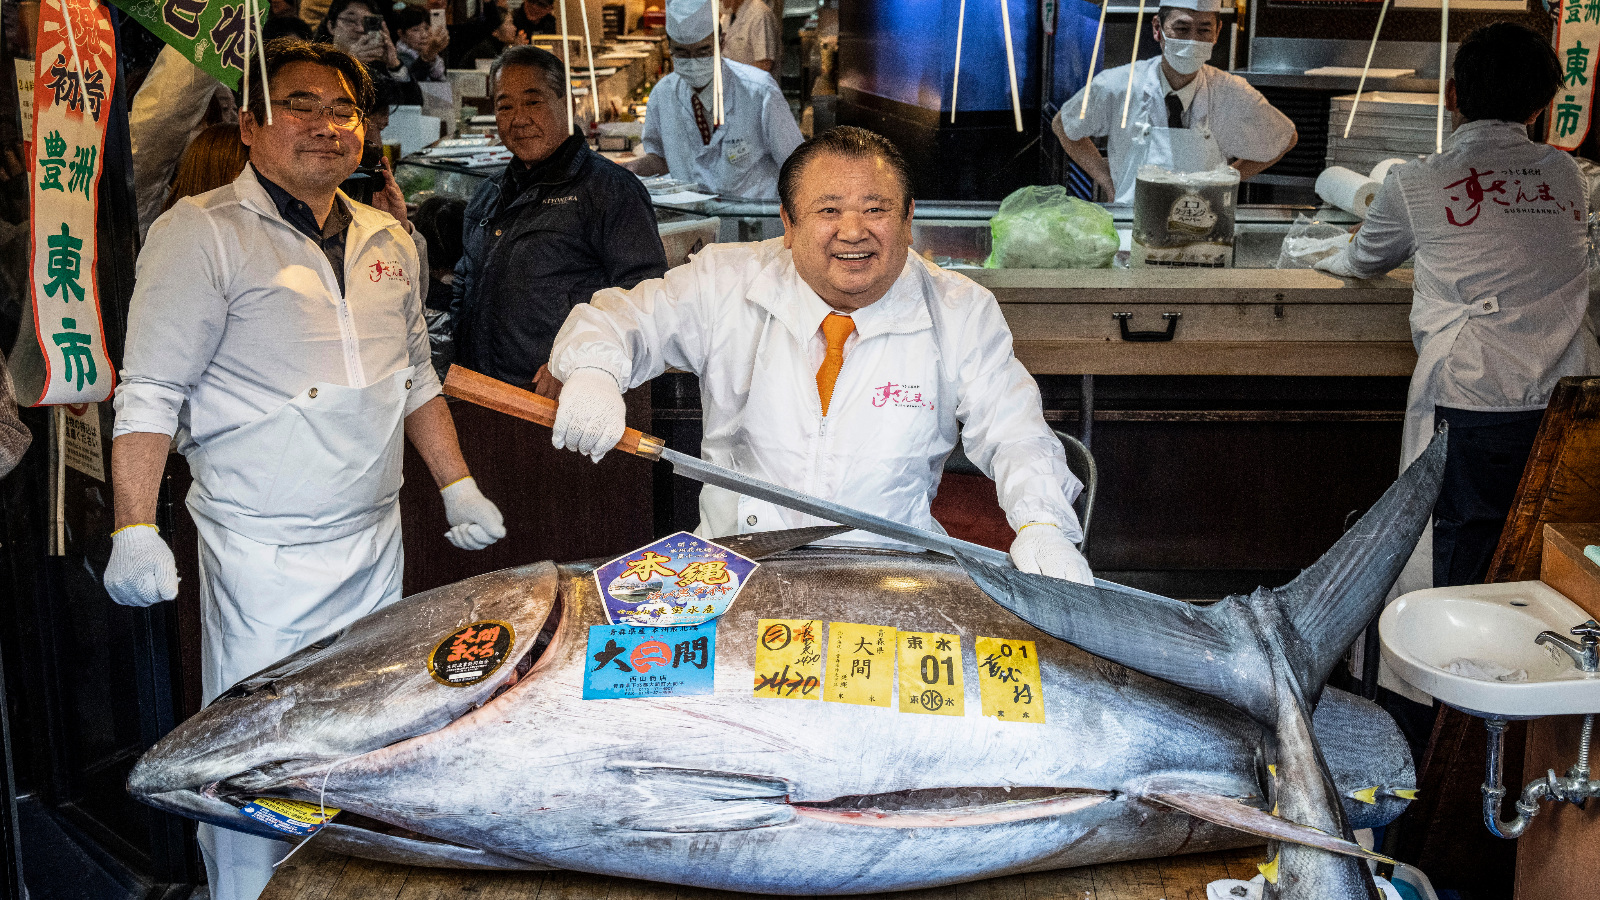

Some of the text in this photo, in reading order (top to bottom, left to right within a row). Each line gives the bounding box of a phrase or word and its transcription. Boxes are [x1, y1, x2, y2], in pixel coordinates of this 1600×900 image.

[39, 130, 97, 201] 豊洲
[620, 551, 731, 587] 本縄
[850, 636, 875, 680] 大間
[1000, 644, 1028, 658] 01
[921, 655, 954, 685] 01
